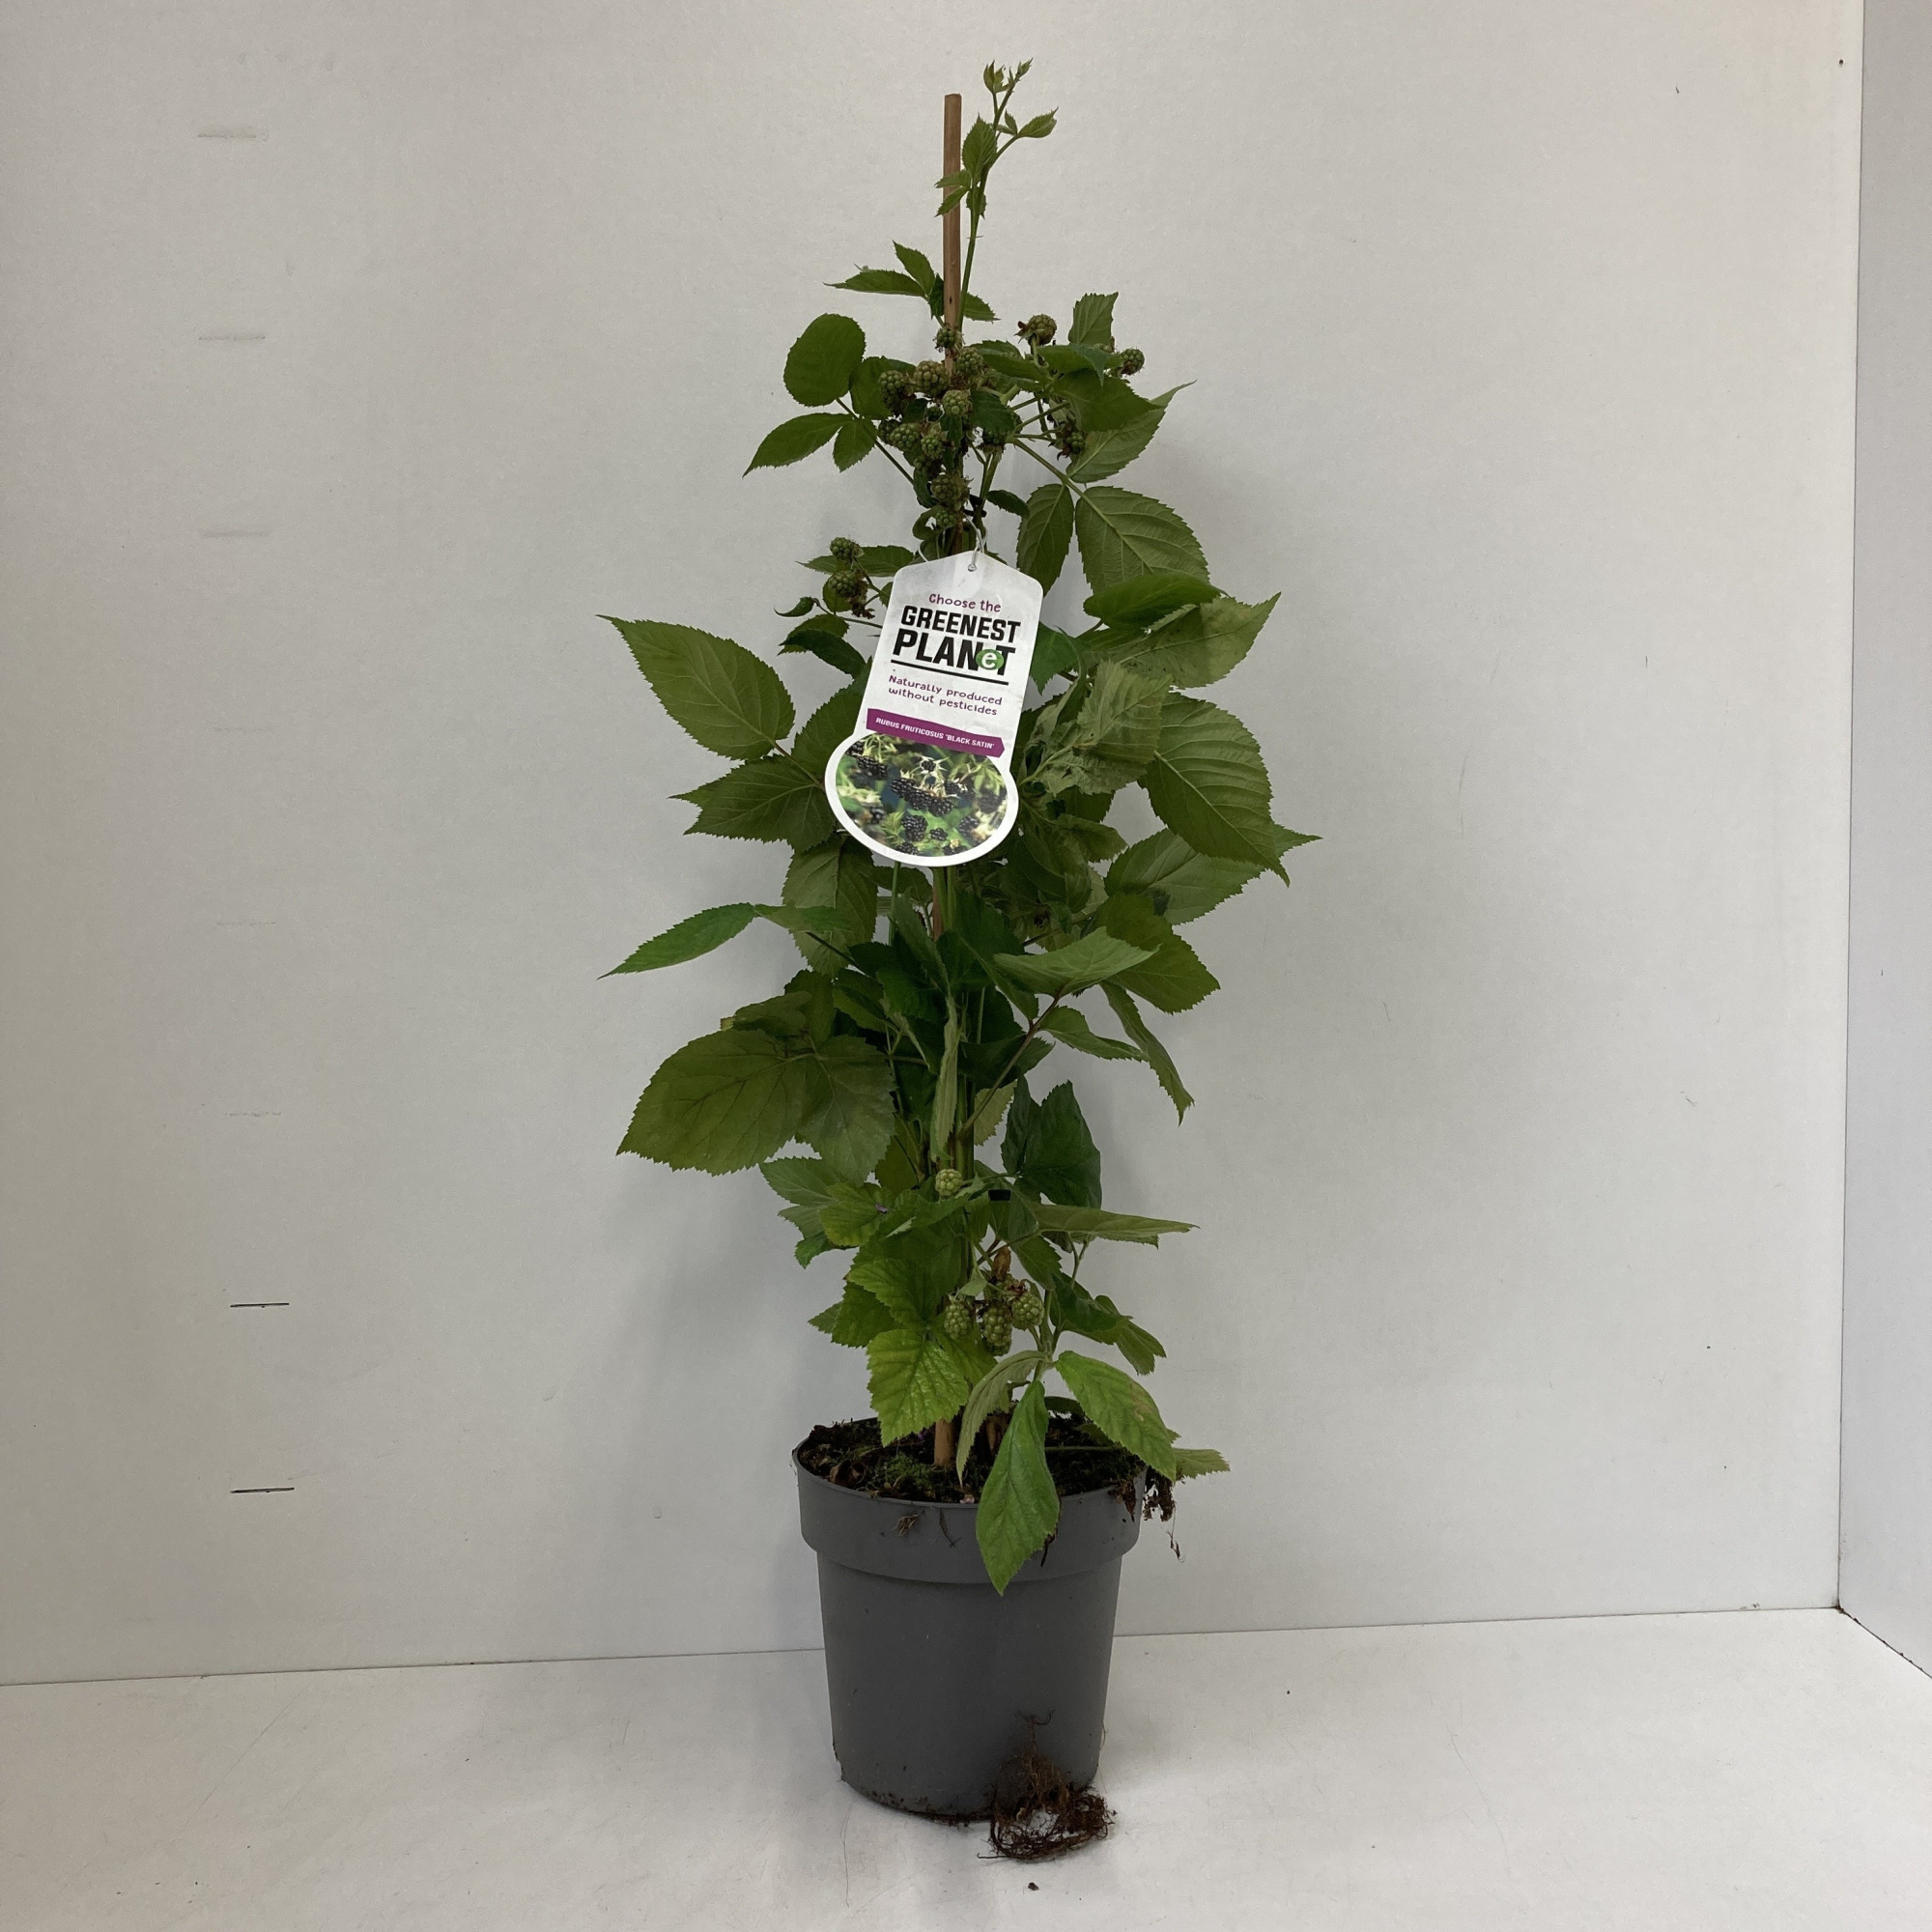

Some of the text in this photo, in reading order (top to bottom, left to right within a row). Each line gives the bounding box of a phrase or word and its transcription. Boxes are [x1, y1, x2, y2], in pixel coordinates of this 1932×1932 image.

[928, 593, 1002, 612] Choose the
[900, 605, 1021, 643] GREENEST
[888, 687, 998, 716] without pesticides
[889, 674, 1003, 705] Naturally produced
[875, 717, 900, 729] RUBUS
[900, 724, 945, 739] FRUTICOSUS
